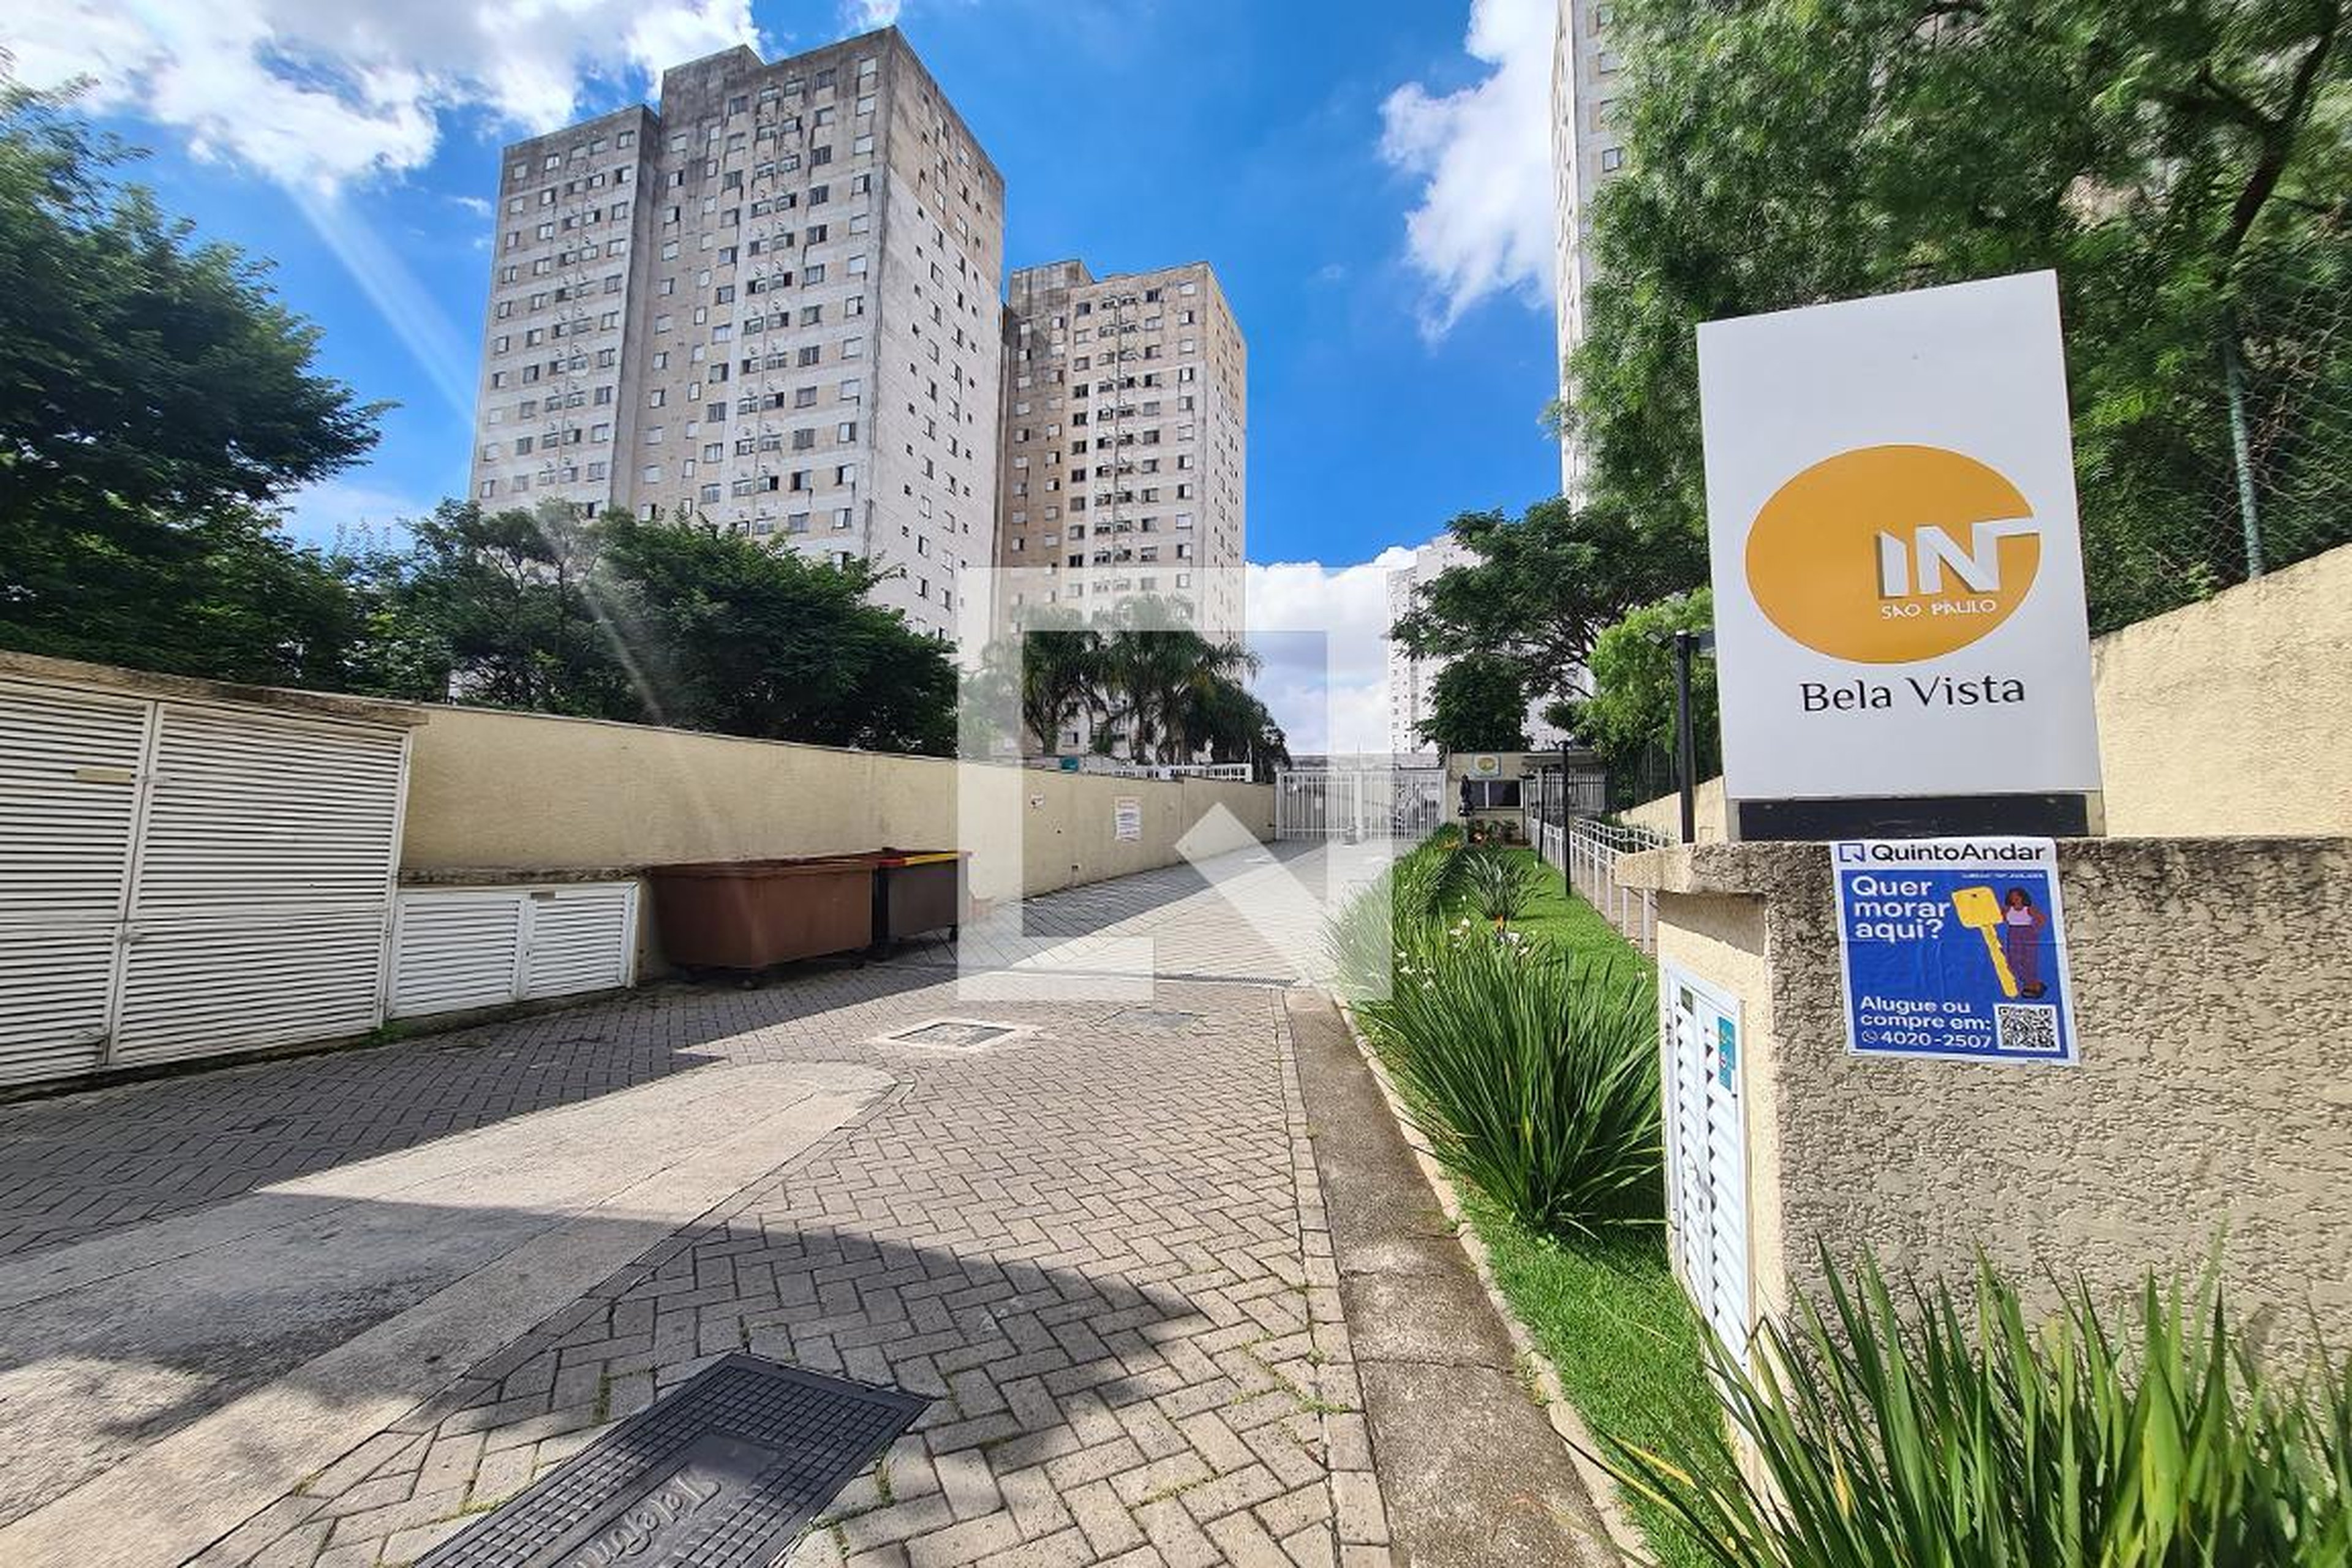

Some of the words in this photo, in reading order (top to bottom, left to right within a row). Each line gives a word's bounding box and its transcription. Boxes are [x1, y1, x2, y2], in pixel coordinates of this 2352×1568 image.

[1877, 516, 2040, 598] IN
[1931, 599, 1996, 616] PAULO
[1800, 679, 1892, 711] Bela
[1905, 675, 2024, 705] Vista
[1871, 843, 2046, 862] QuintoAndar
[1852, 876, 1932, 896] Quer
[1854, 901, 1951, 918] morar
[1855, 919, 1944, 943] aqui?
[1860, 995, 1937, 1015] Alugue
[1942, 1002, 1971, 1014] ou
[1860, 1014, 1945, 1030] compre
[1950, 1017, 1991, 1030] em:
